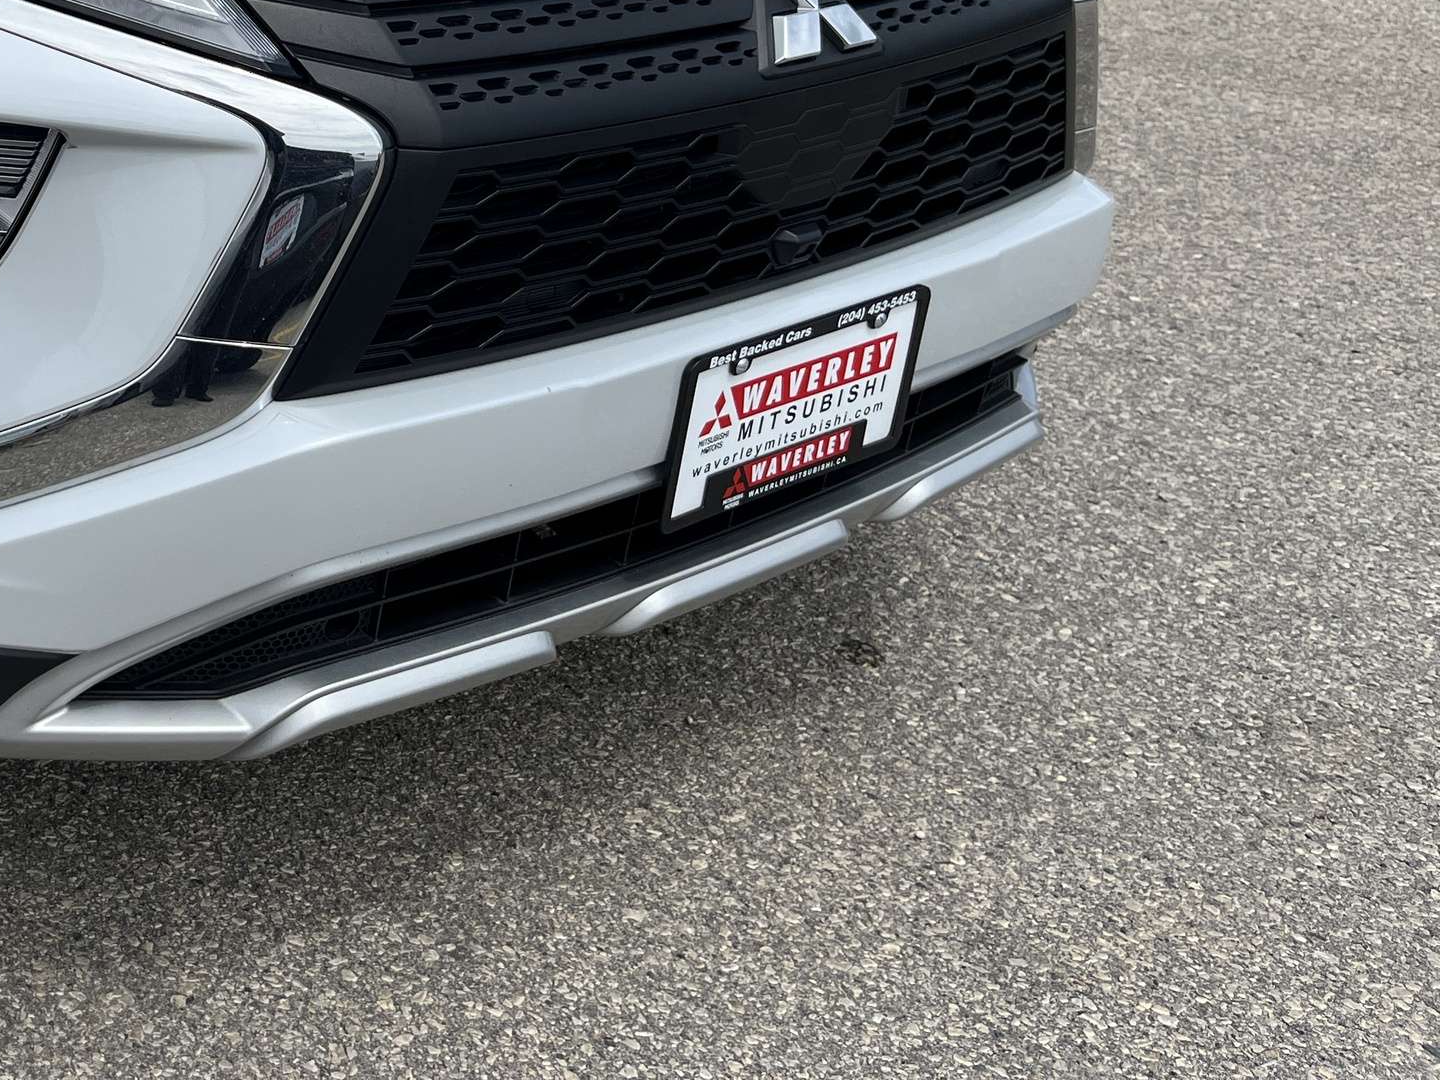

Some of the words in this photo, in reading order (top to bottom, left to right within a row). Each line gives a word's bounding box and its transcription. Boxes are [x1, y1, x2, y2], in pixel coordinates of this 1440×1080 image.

[710, 352, 738, 369] Best
[739, 333, 783, 358] Backed
[785, 326, 812, 344] Cars
[837, 306, 866, 328] (204)
[867, 290, 917, 316] 453-5453
[737, 374, 887, 441] MITSUBISHI
[740, 337, 896, 414] WAVERLEY
[691, 400, 884, 478] waverleymitsubishi.com
[750, 430, 851, 483] WAVERLEY
[748, 456, 847, 498] WAVERLEYMITSUBISHI.CA
